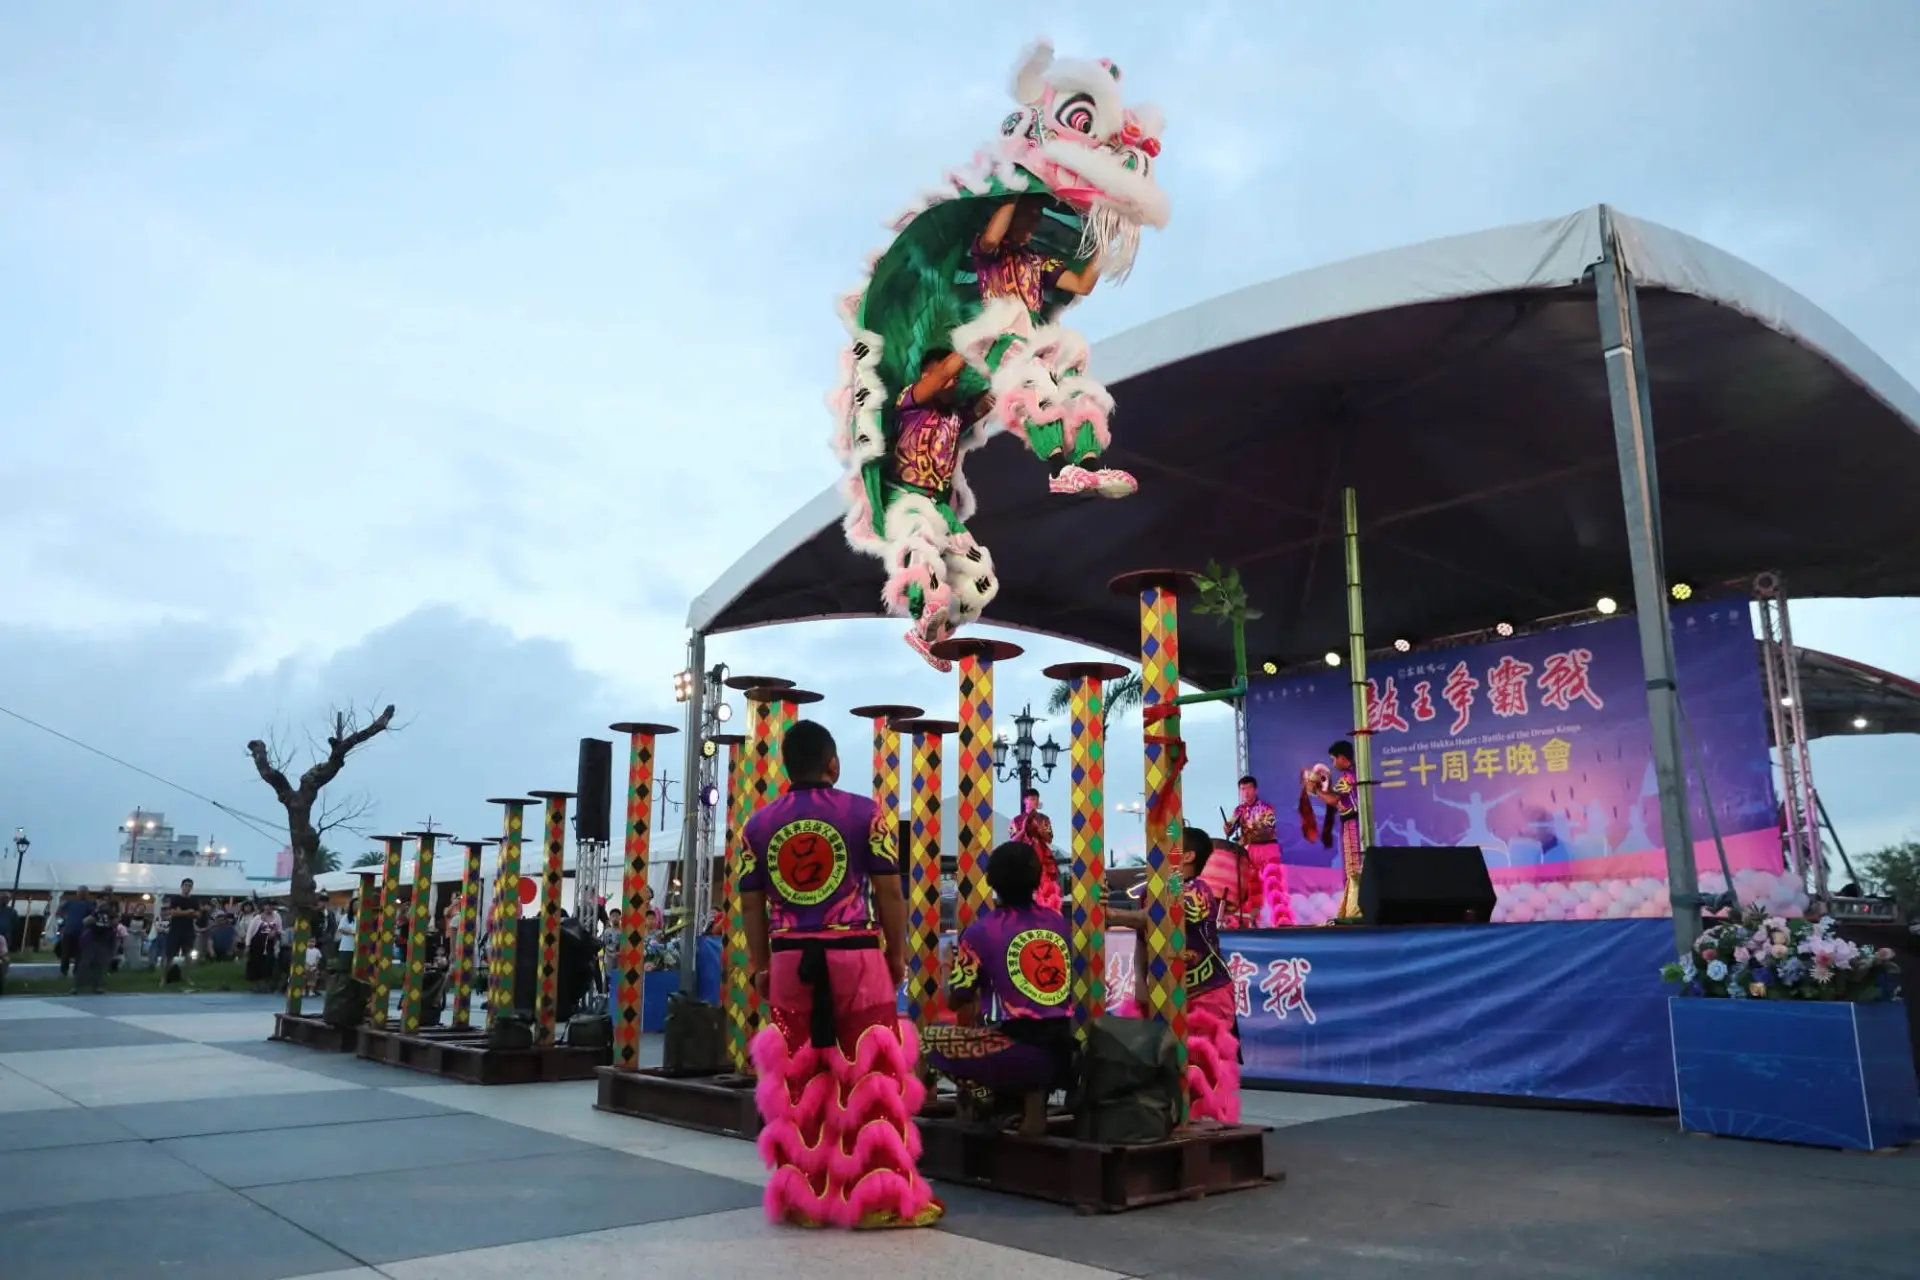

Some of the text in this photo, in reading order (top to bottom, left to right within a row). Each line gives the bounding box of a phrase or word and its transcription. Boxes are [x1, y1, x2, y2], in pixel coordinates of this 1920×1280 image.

[1408, 743, 1416, 752] of
[1416, 741, 1429, 751] the
[1430, 738, 1454, 749] Hakka
[1482, 732, 1505, 744] Battle
[1506, 731, 1515, 740] of
[1516, 729, 1530, 739] the
[1530, 727, 1555, 737] Drum
[1380, 737, 1571, 788] 三十周年晚會
